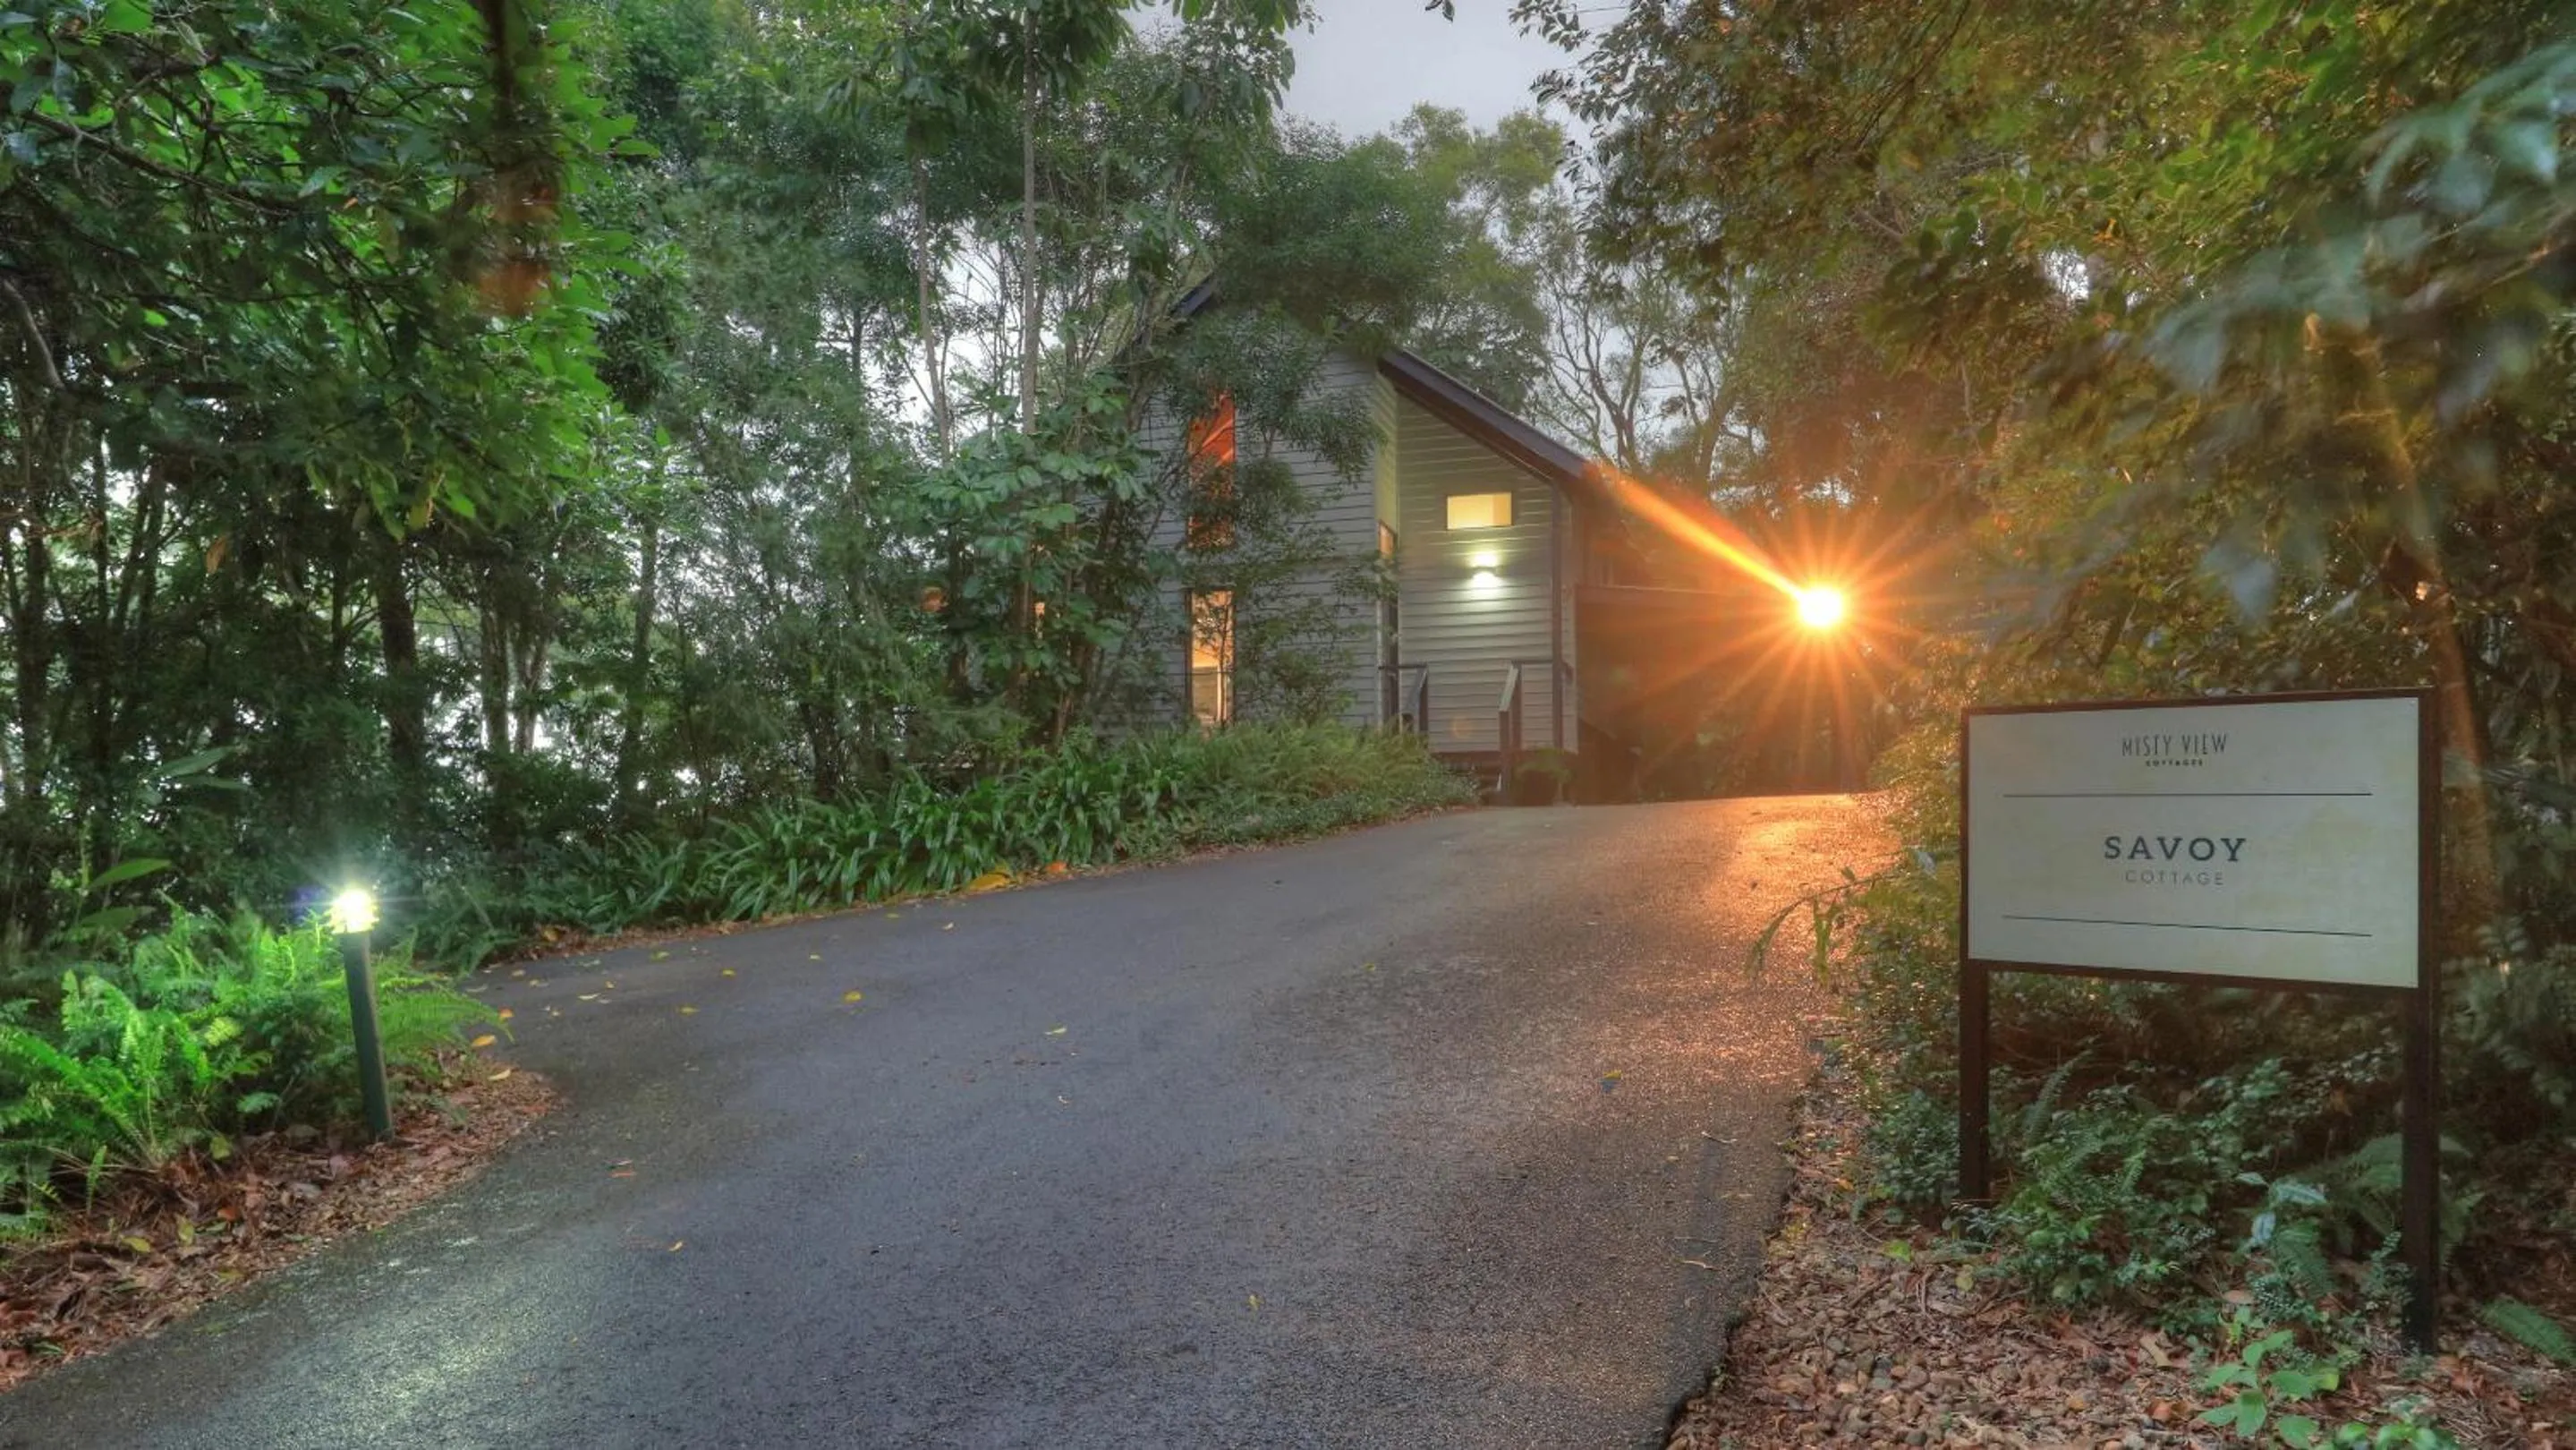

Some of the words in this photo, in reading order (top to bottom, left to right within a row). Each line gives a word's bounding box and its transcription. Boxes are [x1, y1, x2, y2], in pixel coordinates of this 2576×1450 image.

[2121, 734, 2172, 757] MISTY
[2181, 733, 2227, 755] VIEW
[2104, 835, 2247, 862] SAVOY
[2125, 869, 2224, 886] COTTAGE
